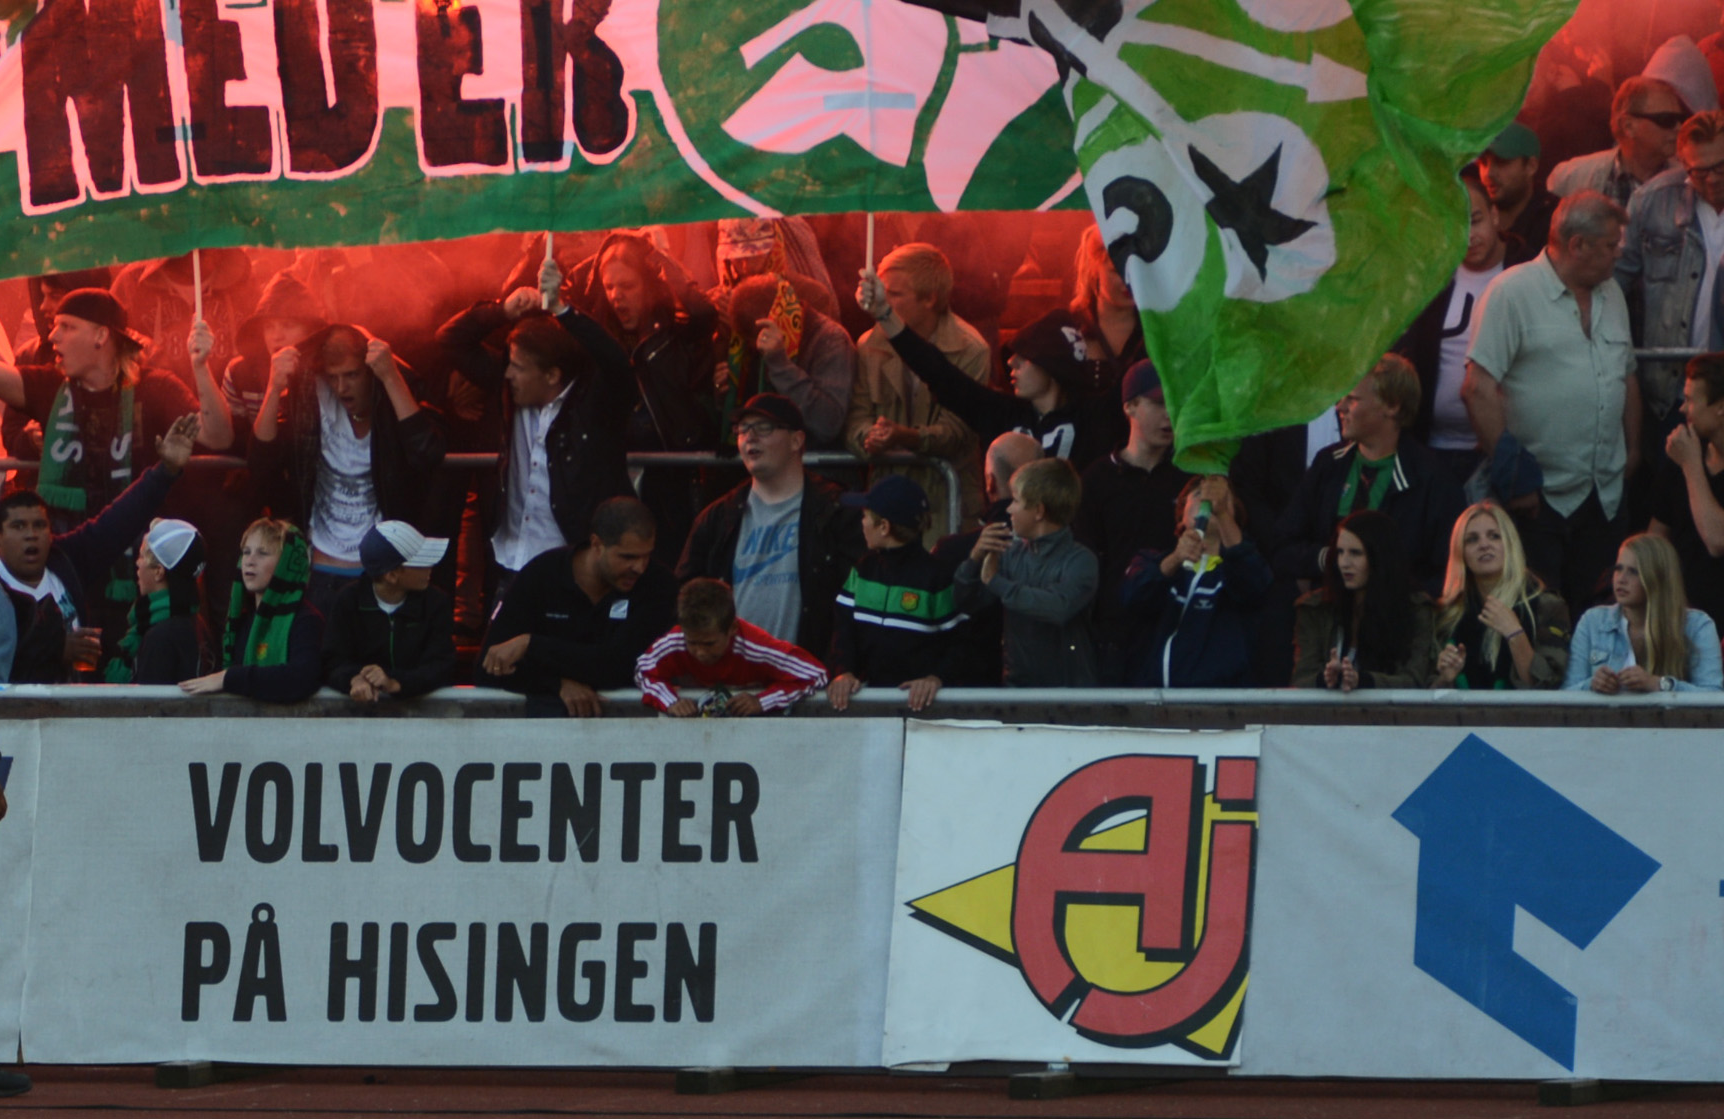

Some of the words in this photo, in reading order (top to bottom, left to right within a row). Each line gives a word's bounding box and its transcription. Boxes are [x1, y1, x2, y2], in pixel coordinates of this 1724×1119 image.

[188, 761, 760, 864] VOLVOCENTER
[181, 902, 287, 1023] PÅ
[326, 921, 718, 1023] HISINGEN
